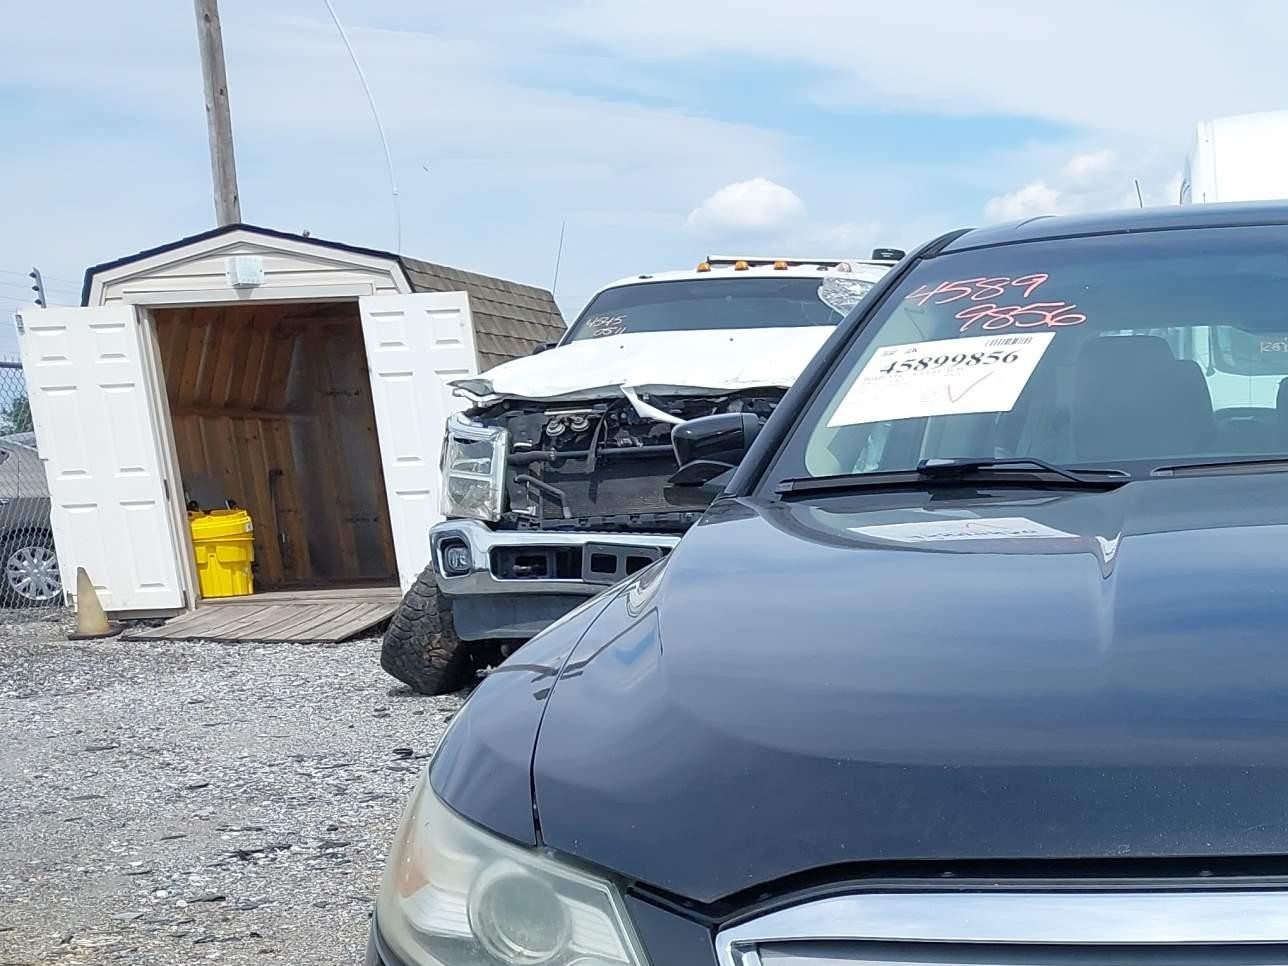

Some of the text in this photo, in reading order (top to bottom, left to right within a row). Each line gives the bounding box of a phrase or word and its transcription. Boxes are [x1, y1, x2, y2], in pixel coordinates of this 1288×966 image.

[904, 273, 1049, 306] 4589
[954, 302, 1087, 332] 9856
[880, 349, 1021, 375] 45899856
